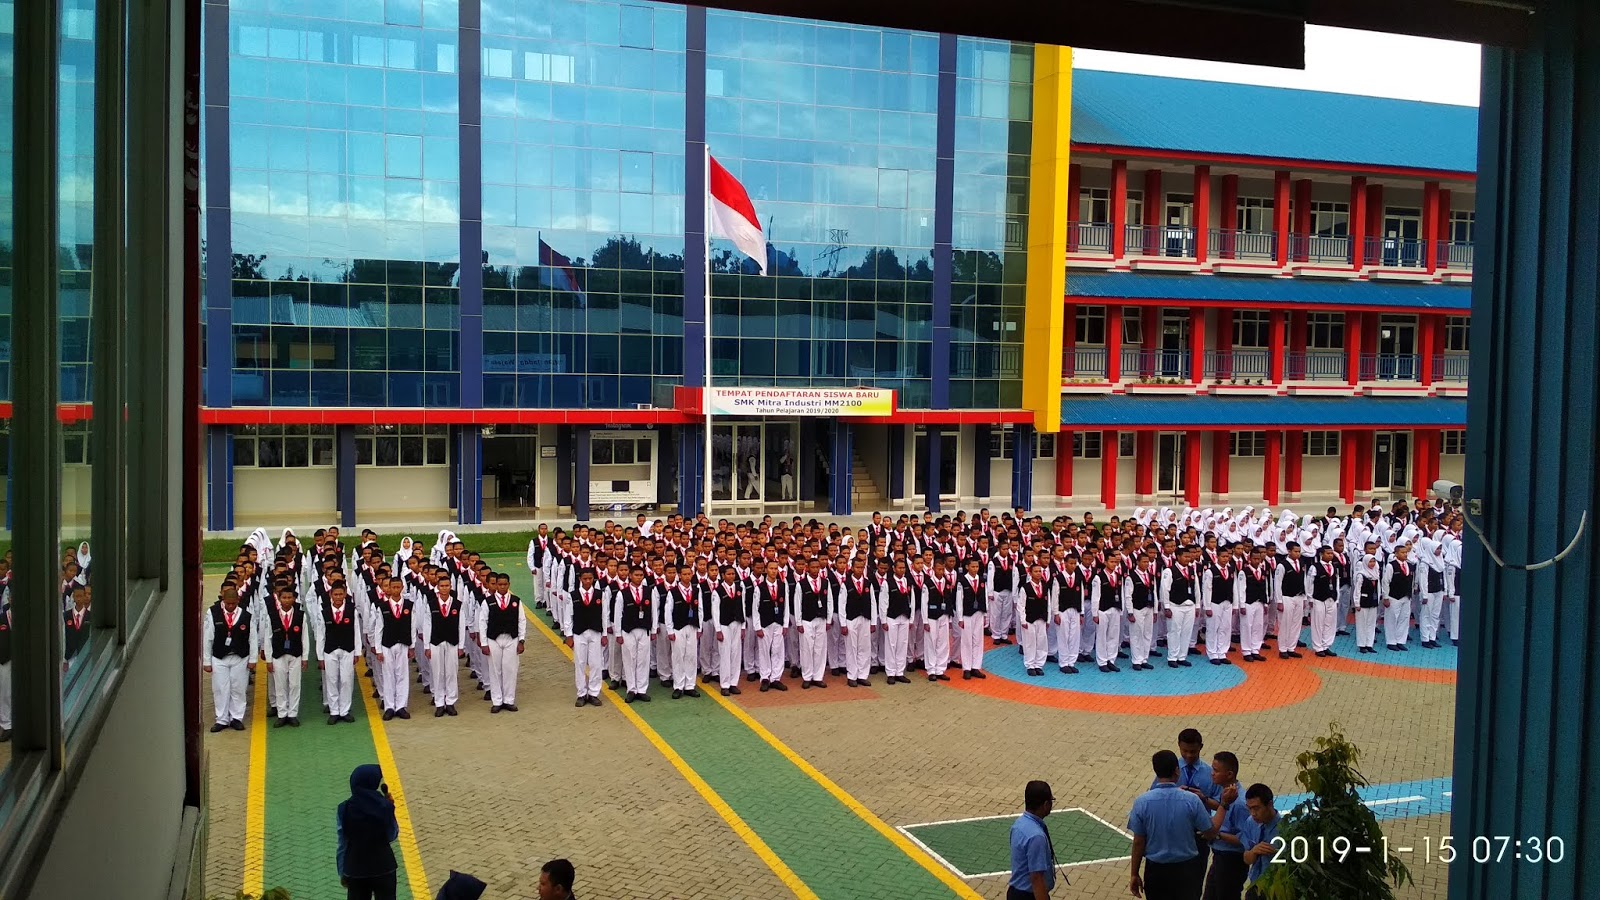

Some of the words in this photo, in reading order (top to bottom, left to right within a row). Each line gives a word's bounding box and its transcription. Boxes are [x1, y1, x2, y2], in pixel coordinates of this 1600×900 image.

[715, 389, 753, 397] TEMPAT
[755, 390, 821, 398] PENDAFTARAN
[856, 391, 880, 399] BARU
[734, 398, 755, 406] SMK
[785, 399, 822, 407] Industri
